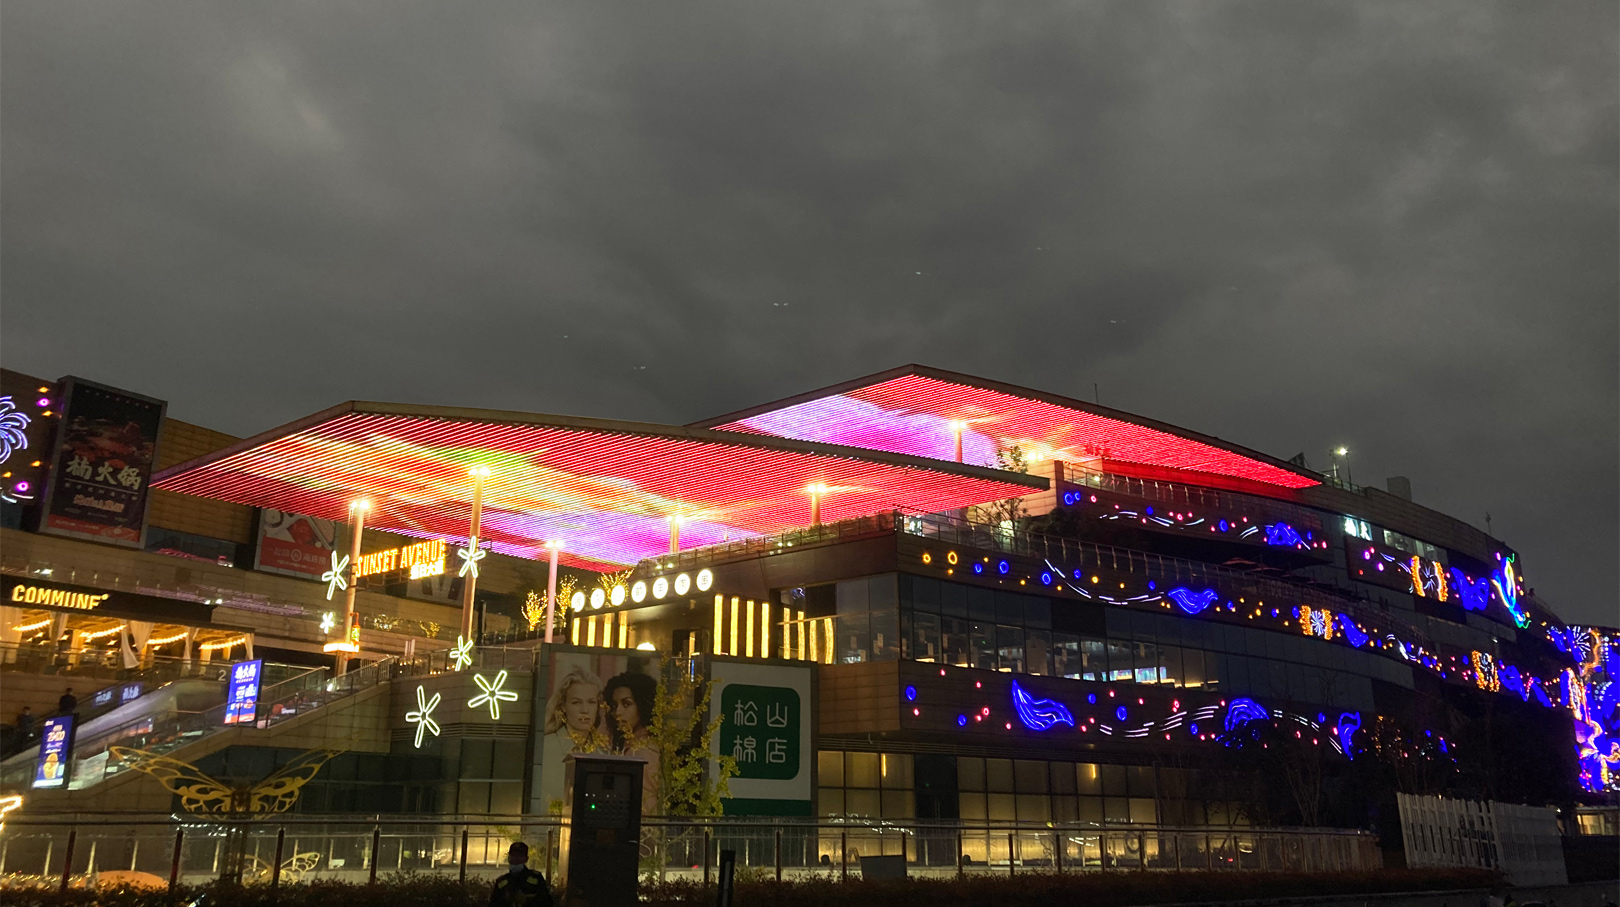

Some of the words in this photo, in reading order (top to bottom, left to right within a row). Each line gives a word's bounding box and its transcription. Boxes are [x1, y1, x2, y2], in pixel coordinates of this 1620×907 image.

[355, 548, 398, 578] SUNSET
[399, 538, 447, 568] AVENUE
[218, 670, 227, 682] 2
[733, 699, 788, 728] 松山
[733, 735, 788, 764] 棉店
